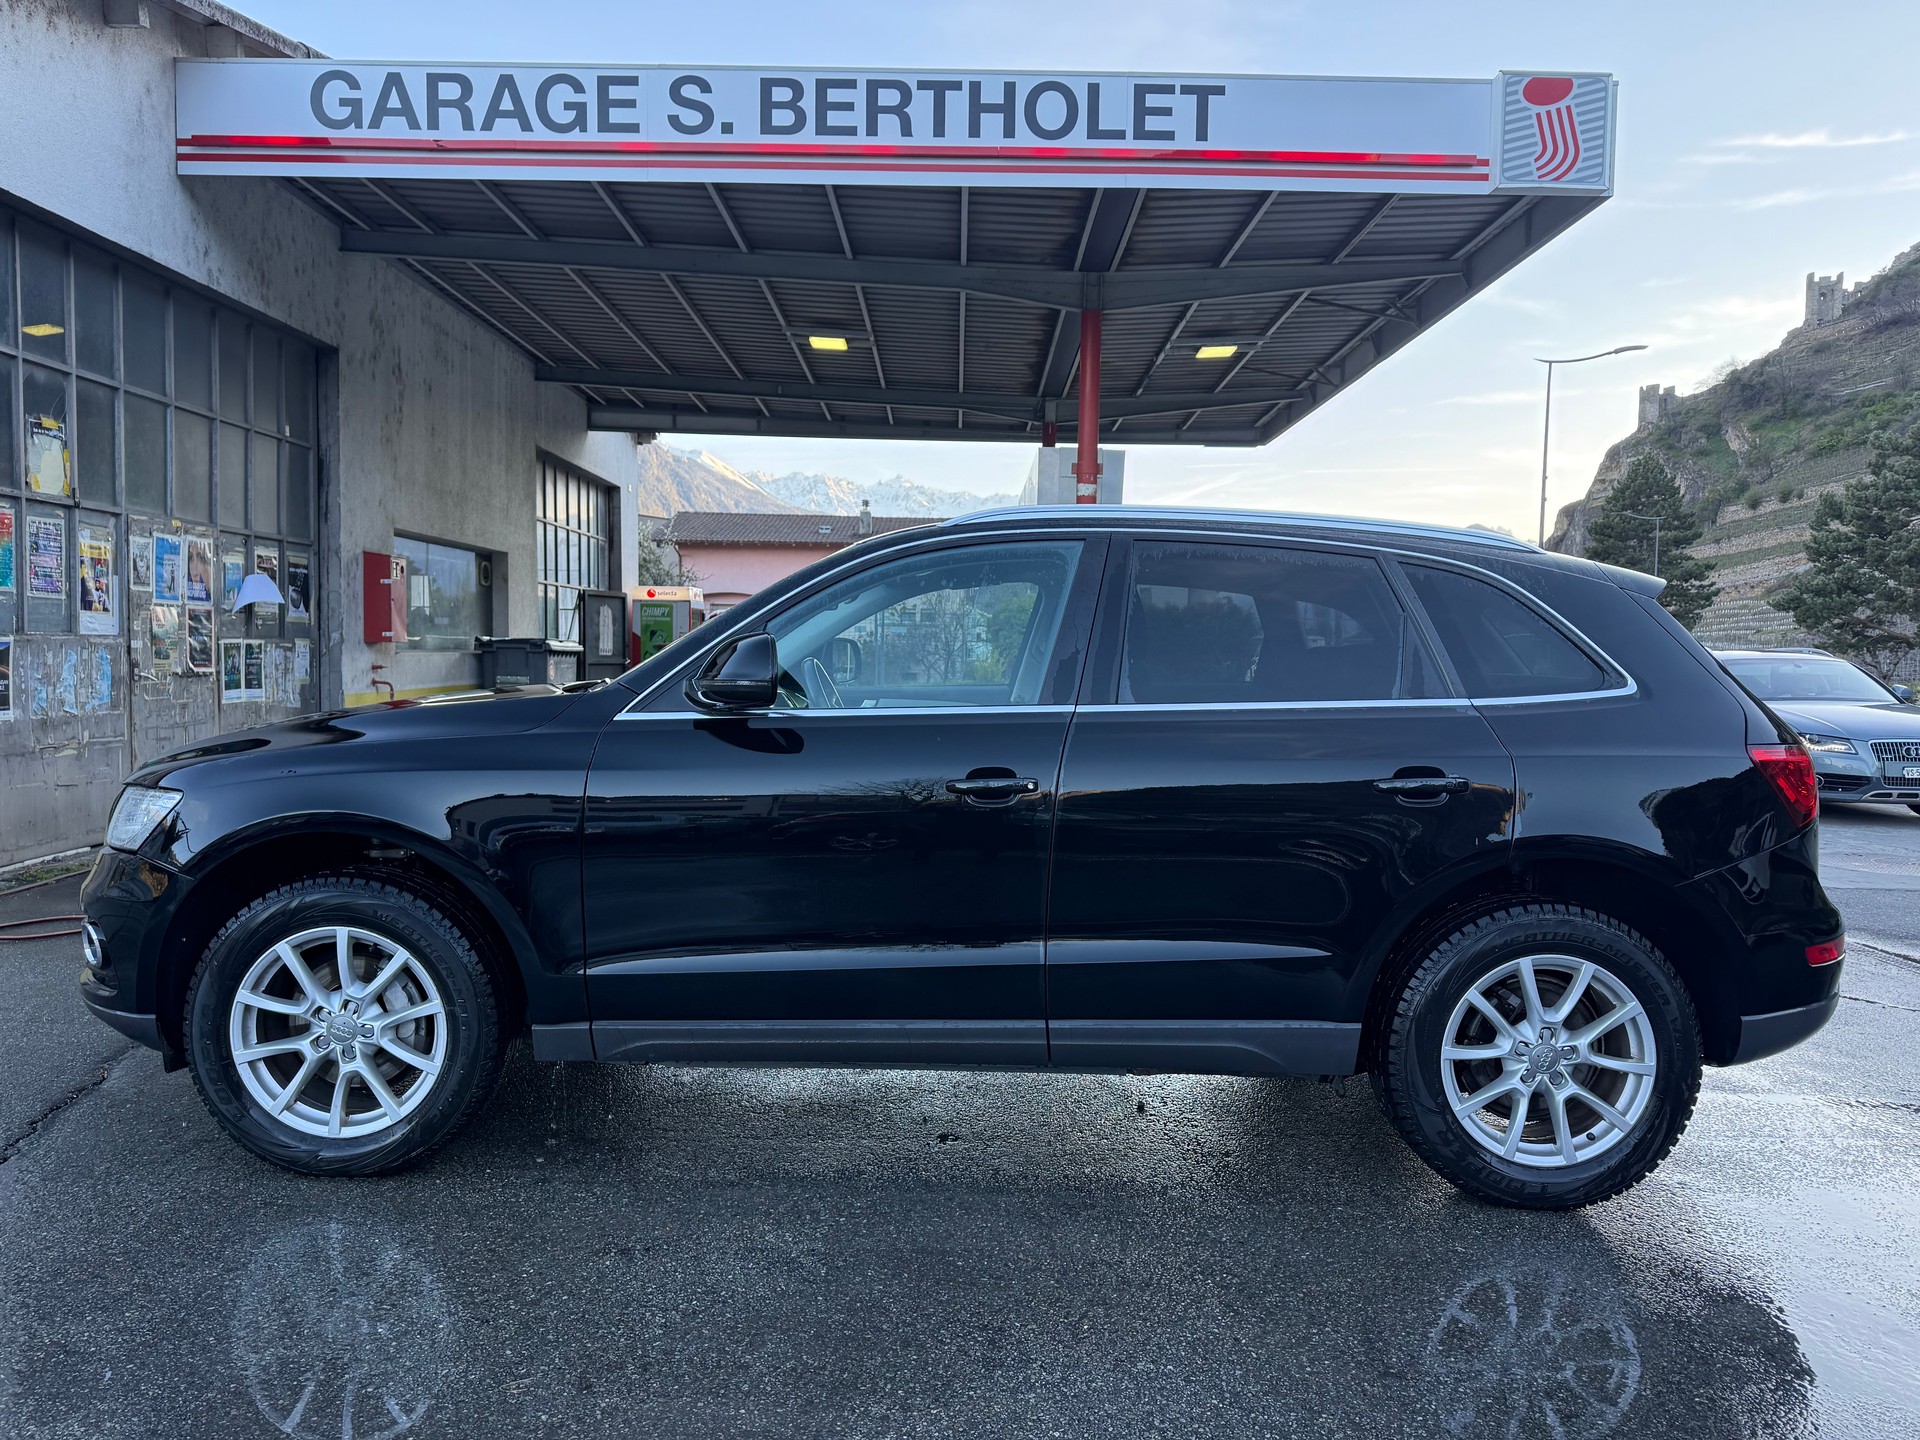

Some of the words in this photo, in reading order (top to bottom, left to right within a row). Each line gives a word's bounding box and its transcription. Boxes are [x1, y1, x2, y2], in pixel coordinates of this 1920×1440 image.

[311, 70, 640, 134] GARAGE
[667, 75, 734, 135] S.
[759, 77, 1226, 142] BERTHOLET
[641, 606, 669, 616] CHIMPY
